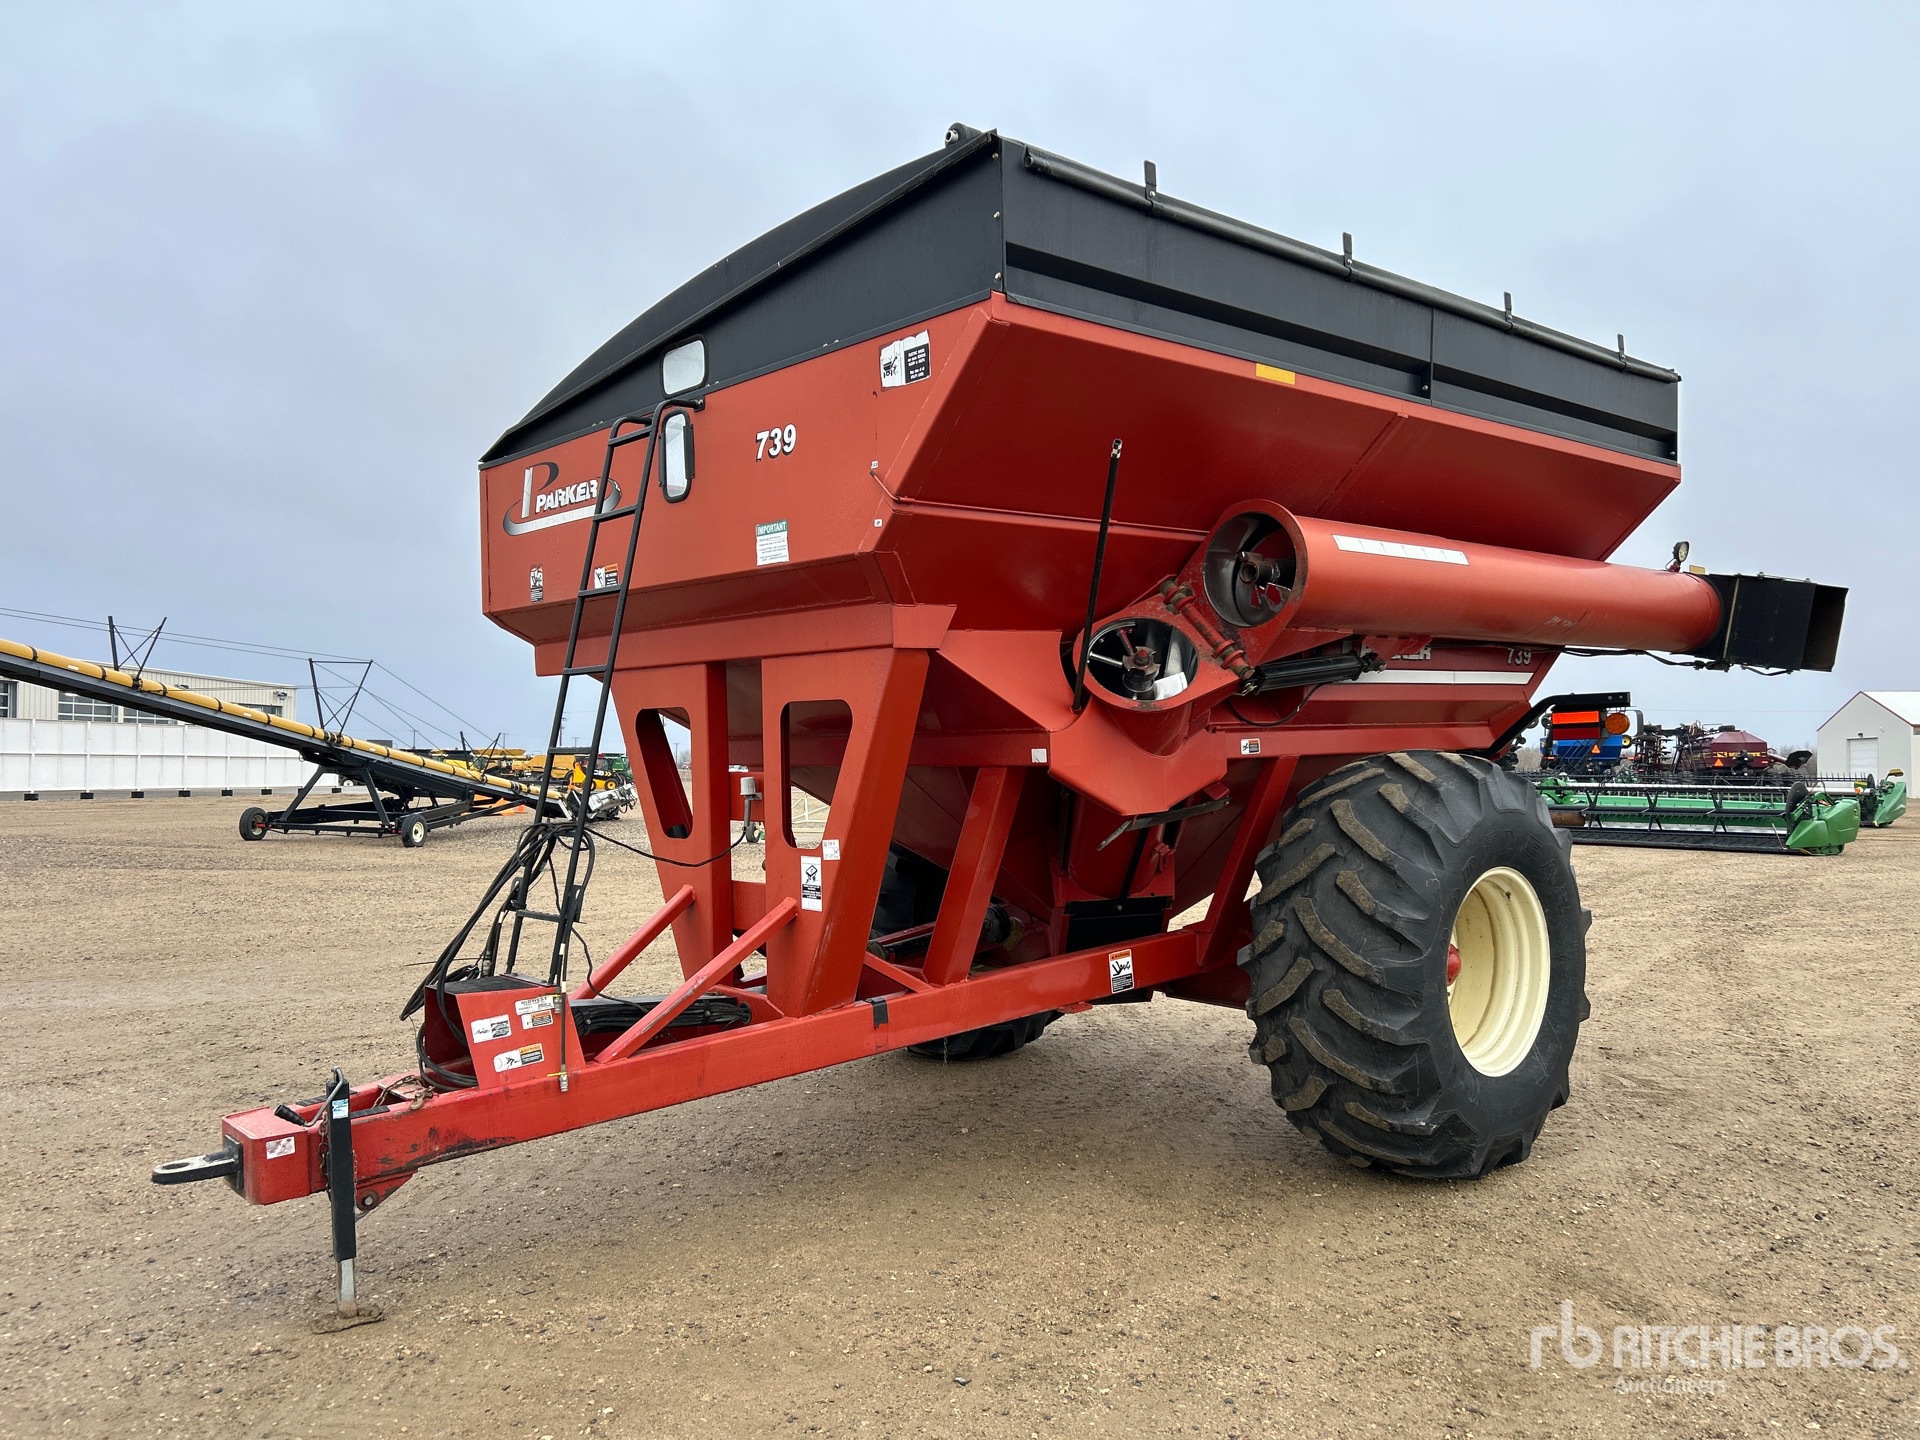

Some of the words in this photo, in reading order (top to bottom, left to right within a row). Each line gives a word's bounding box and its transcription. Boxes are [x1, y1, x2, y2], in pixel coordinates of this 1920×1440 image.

[756, 423, 797, 462] 739
[535, 479, 599, 514] PARKER
[757, 521, 787, 535] IMPORTANT
[1507, 647, 1532, 665] 739
